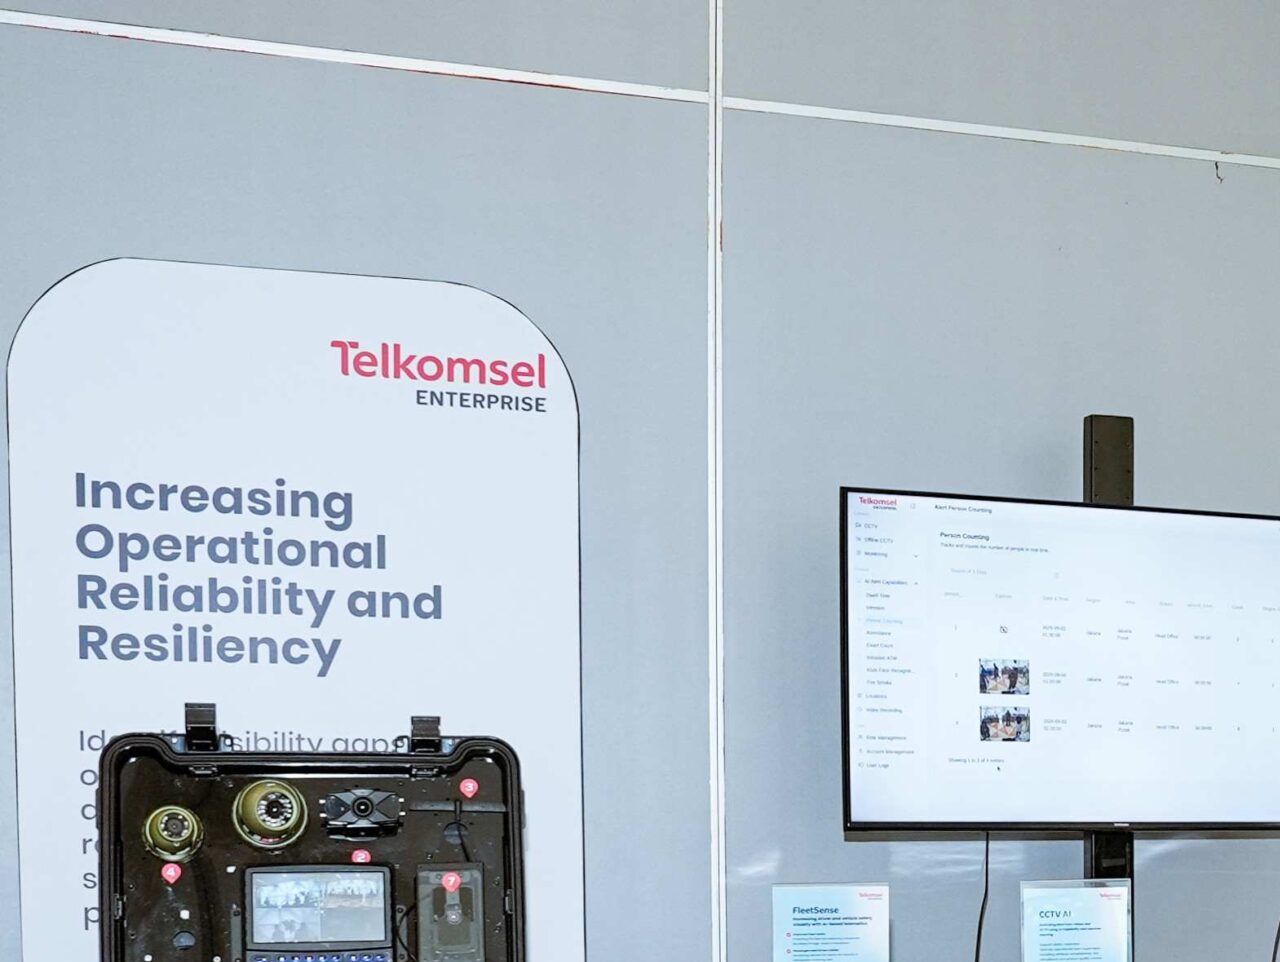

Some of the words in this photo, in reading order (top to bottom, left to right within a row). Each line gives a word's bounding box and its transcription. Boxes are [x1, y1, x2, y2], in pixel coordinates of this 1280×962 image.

[331, 340, 547, 388] Telkomsel
[416, 389, 547, 413] ENTERPRISE
[75, 472, 353, 533] Increasing
[962, 533, 990, 541] Counting
[75, 523, 386, 573] Operational
[77, 572, 336, 630] Reliability
[347, 584, 442, 620] and
[78, 623, 343, 678] Resiliency
[232, 731, 323, 752] sibility
[466, 783, 474, 791] 3
[167, 867, 176, 876] 4
[447, 877, 456, 886] 7
[792, 906, 839, 915] FleetSense
[1038, 910, 1061, 919] CCTV
